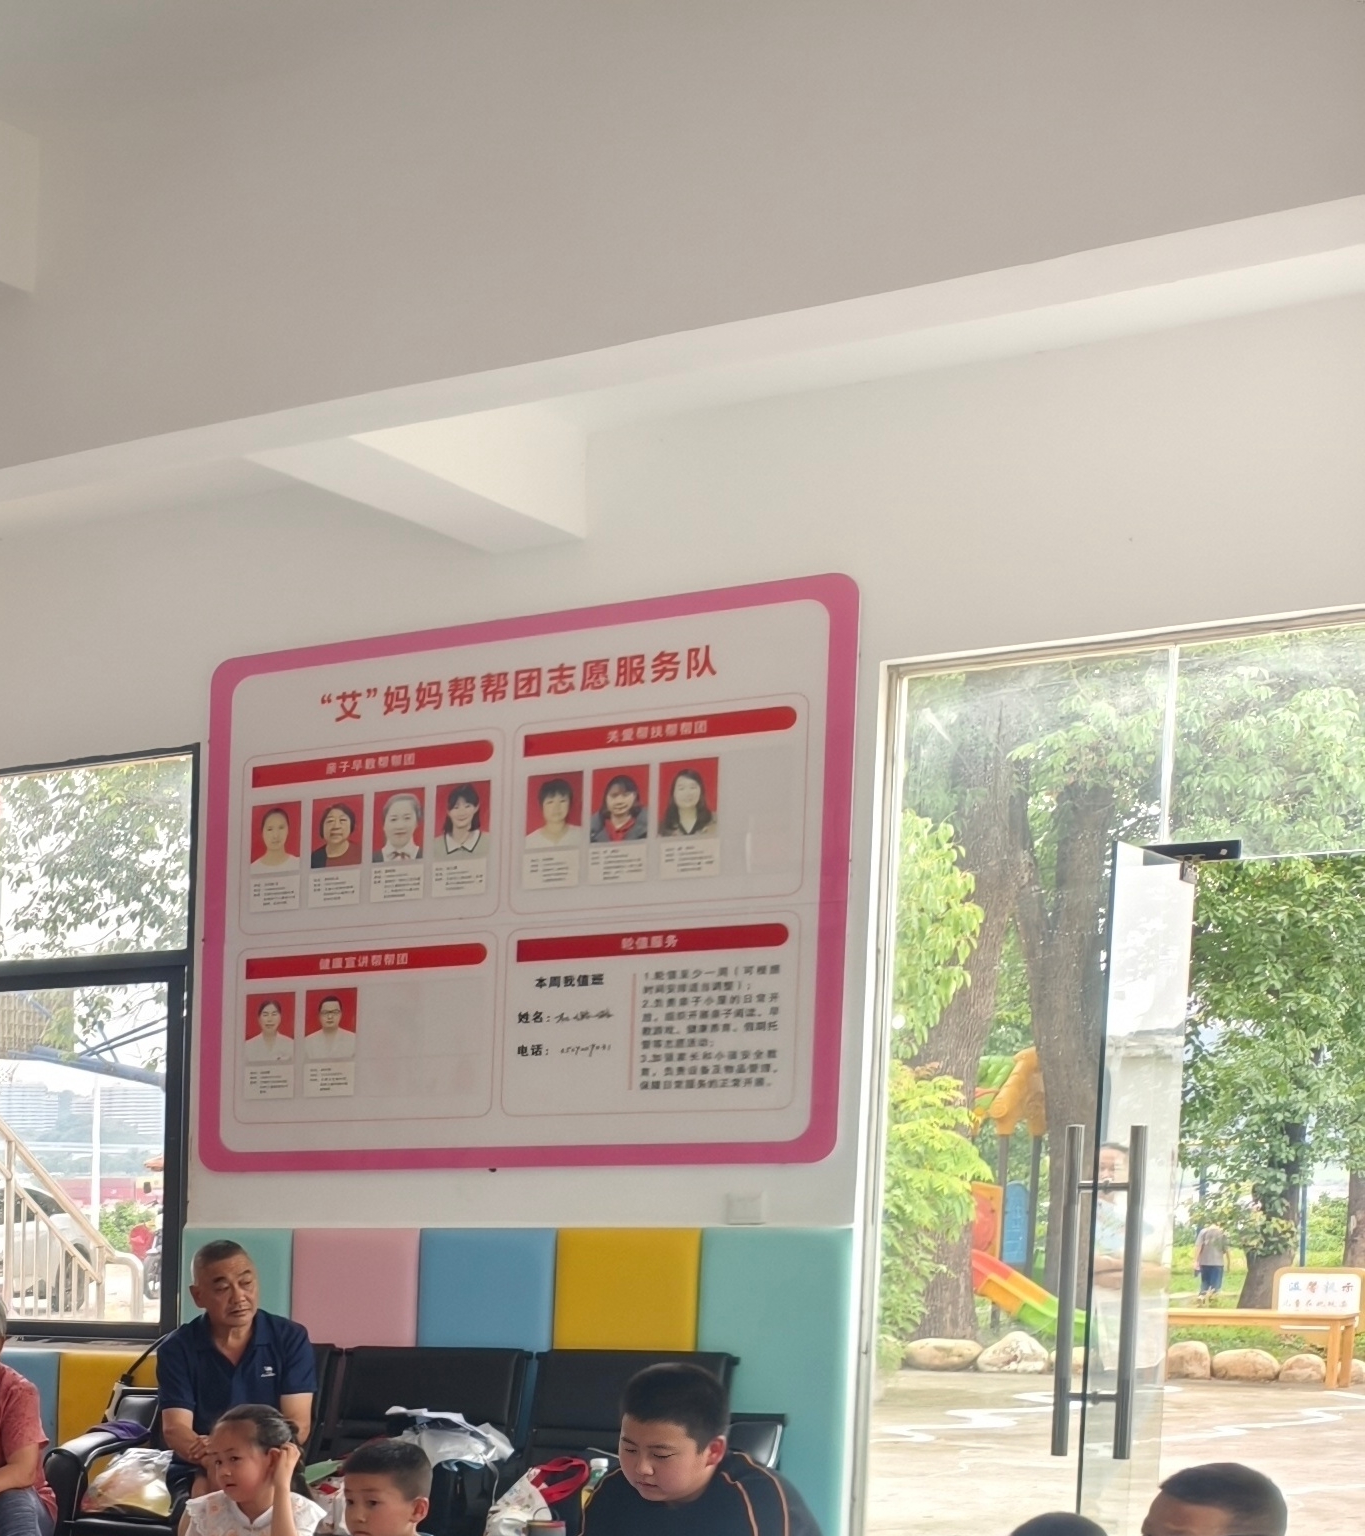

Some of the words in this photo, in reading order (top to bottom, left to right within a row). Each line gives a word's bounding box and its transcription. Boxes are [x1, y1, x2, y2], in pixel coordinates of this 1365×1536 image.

[321, 645, 718, 722] “艾”妈妈帮帮团志愿服务队
